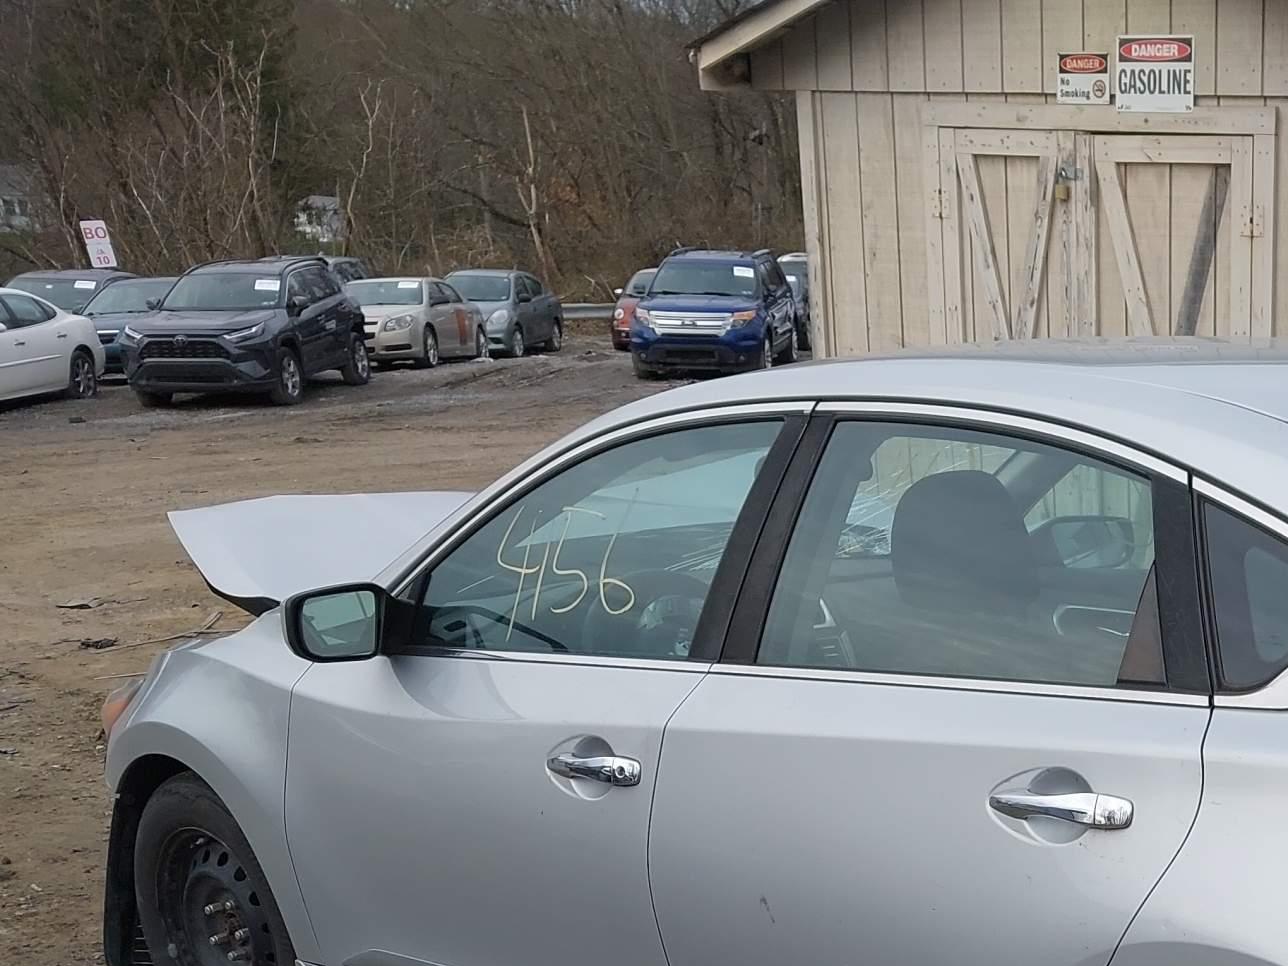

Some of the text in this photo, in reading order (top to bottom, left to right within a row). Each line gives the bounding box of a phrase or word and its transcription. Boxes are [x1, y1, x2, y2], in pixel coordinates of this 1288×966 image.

[1131, 44, 1179, 57] DANGER
[1066, 58, 1100, 69] DANGER
[1060, 77, 1070, 86] No
[1118, 68, 1192, 95] GASOLINE
[1060, 88, 1091, 100] Smoking
